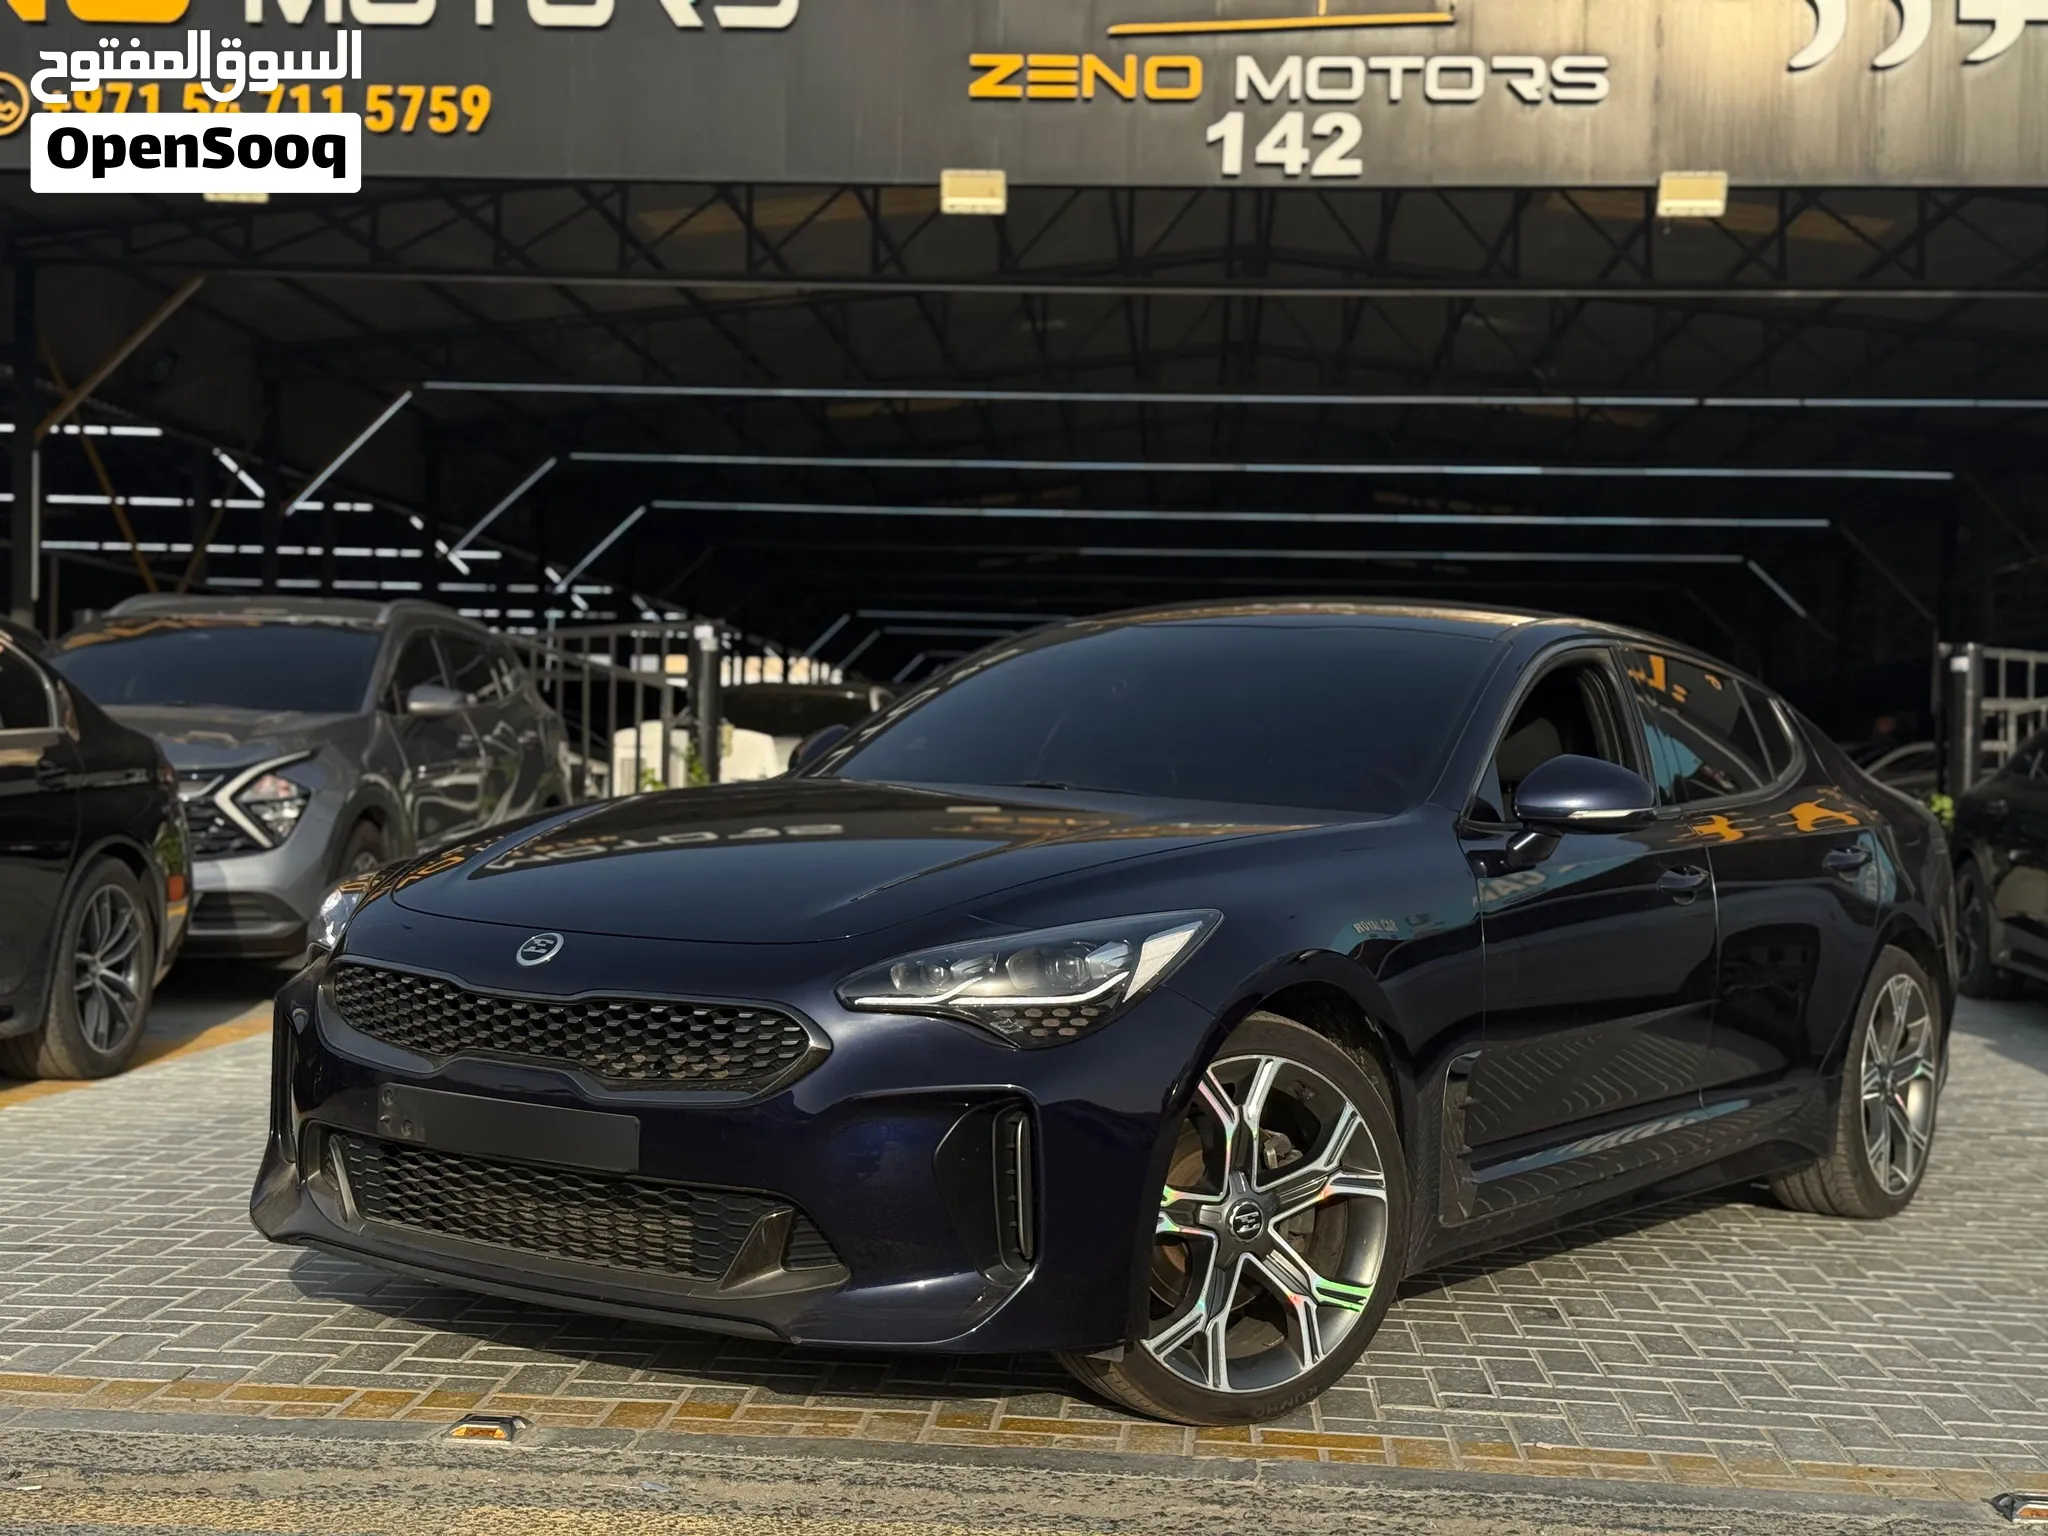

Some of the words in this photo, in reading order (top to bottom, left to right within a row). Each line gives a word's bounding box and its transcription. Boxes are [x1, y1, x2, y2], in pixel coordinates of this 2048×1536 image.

[968, 53, 1203, 100] ZENO
[1235, 55, 1611, 101] MOTORS
[363, 84, 492, 133] 5759
[1206, 110, 1364, 177] 142
[1252, 1384, 1319, 1418] KUMHO
